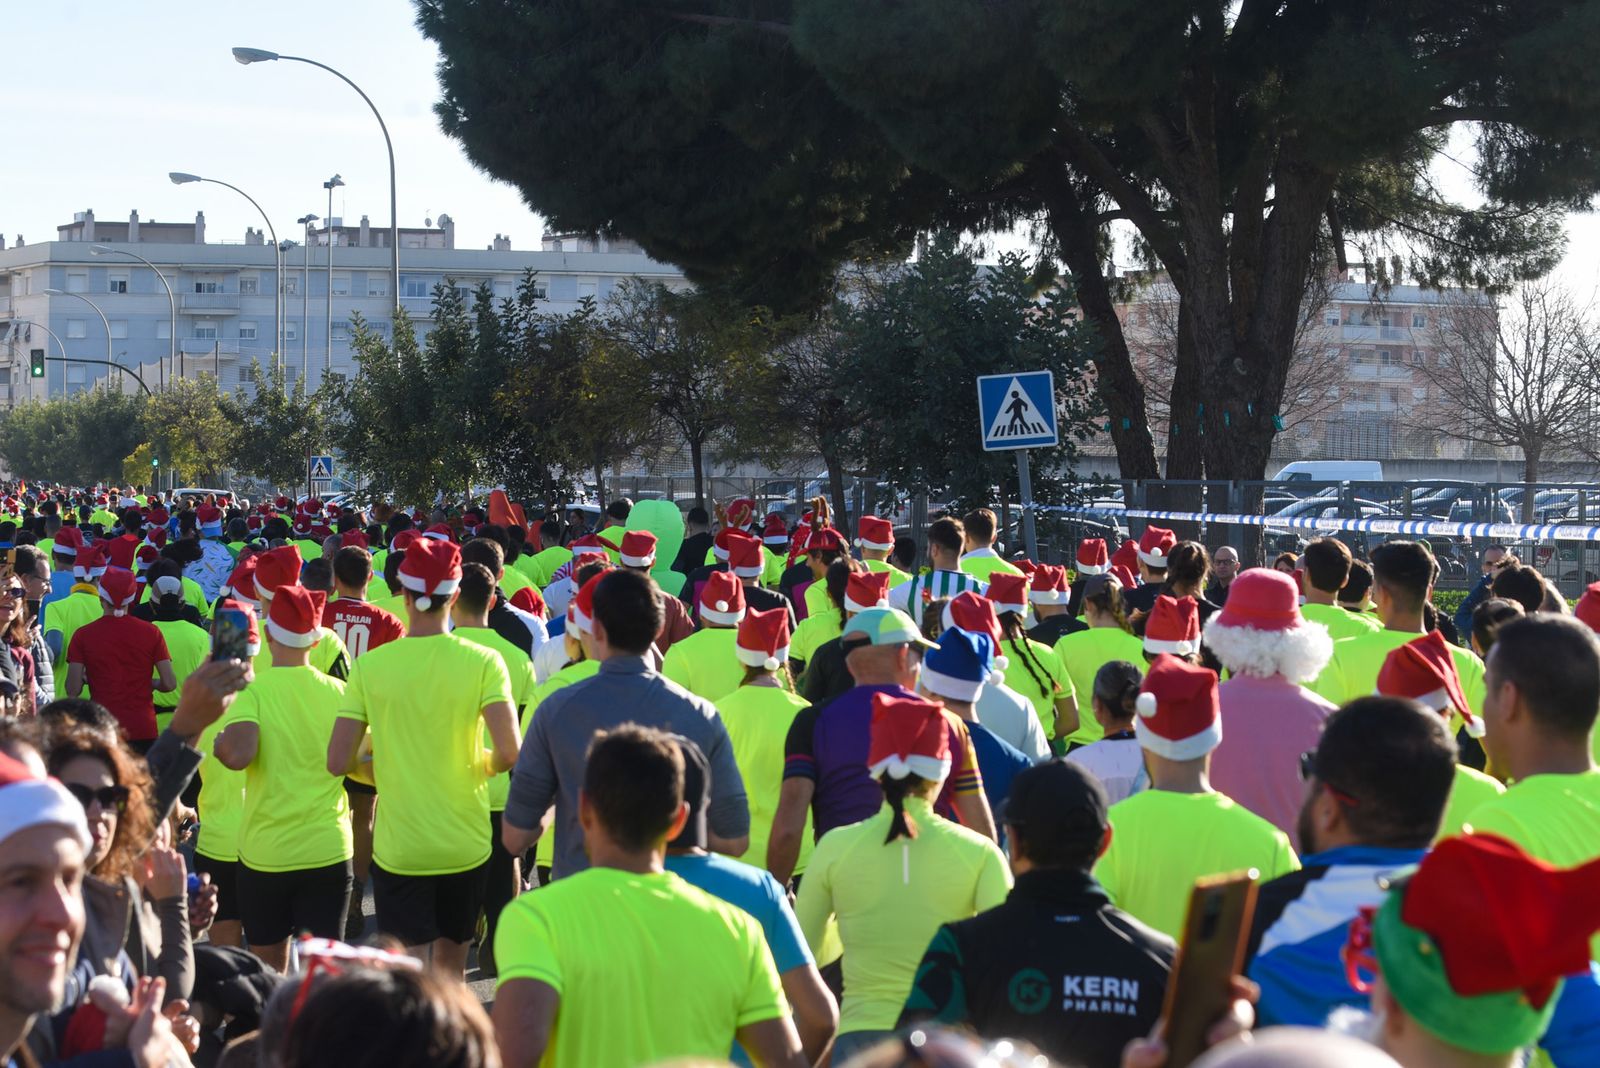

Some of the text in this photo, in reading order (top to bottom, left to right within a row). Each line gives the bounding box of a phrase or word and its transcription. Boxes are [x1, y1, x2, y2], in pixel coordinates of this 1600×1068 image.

[336, 613, 371, 624] M.SALAH
[334, 622, 370, 659] 10
[1064, 975, 1139, 1001] KERN
[1063, 999, 1137, 1016] PHARMA
